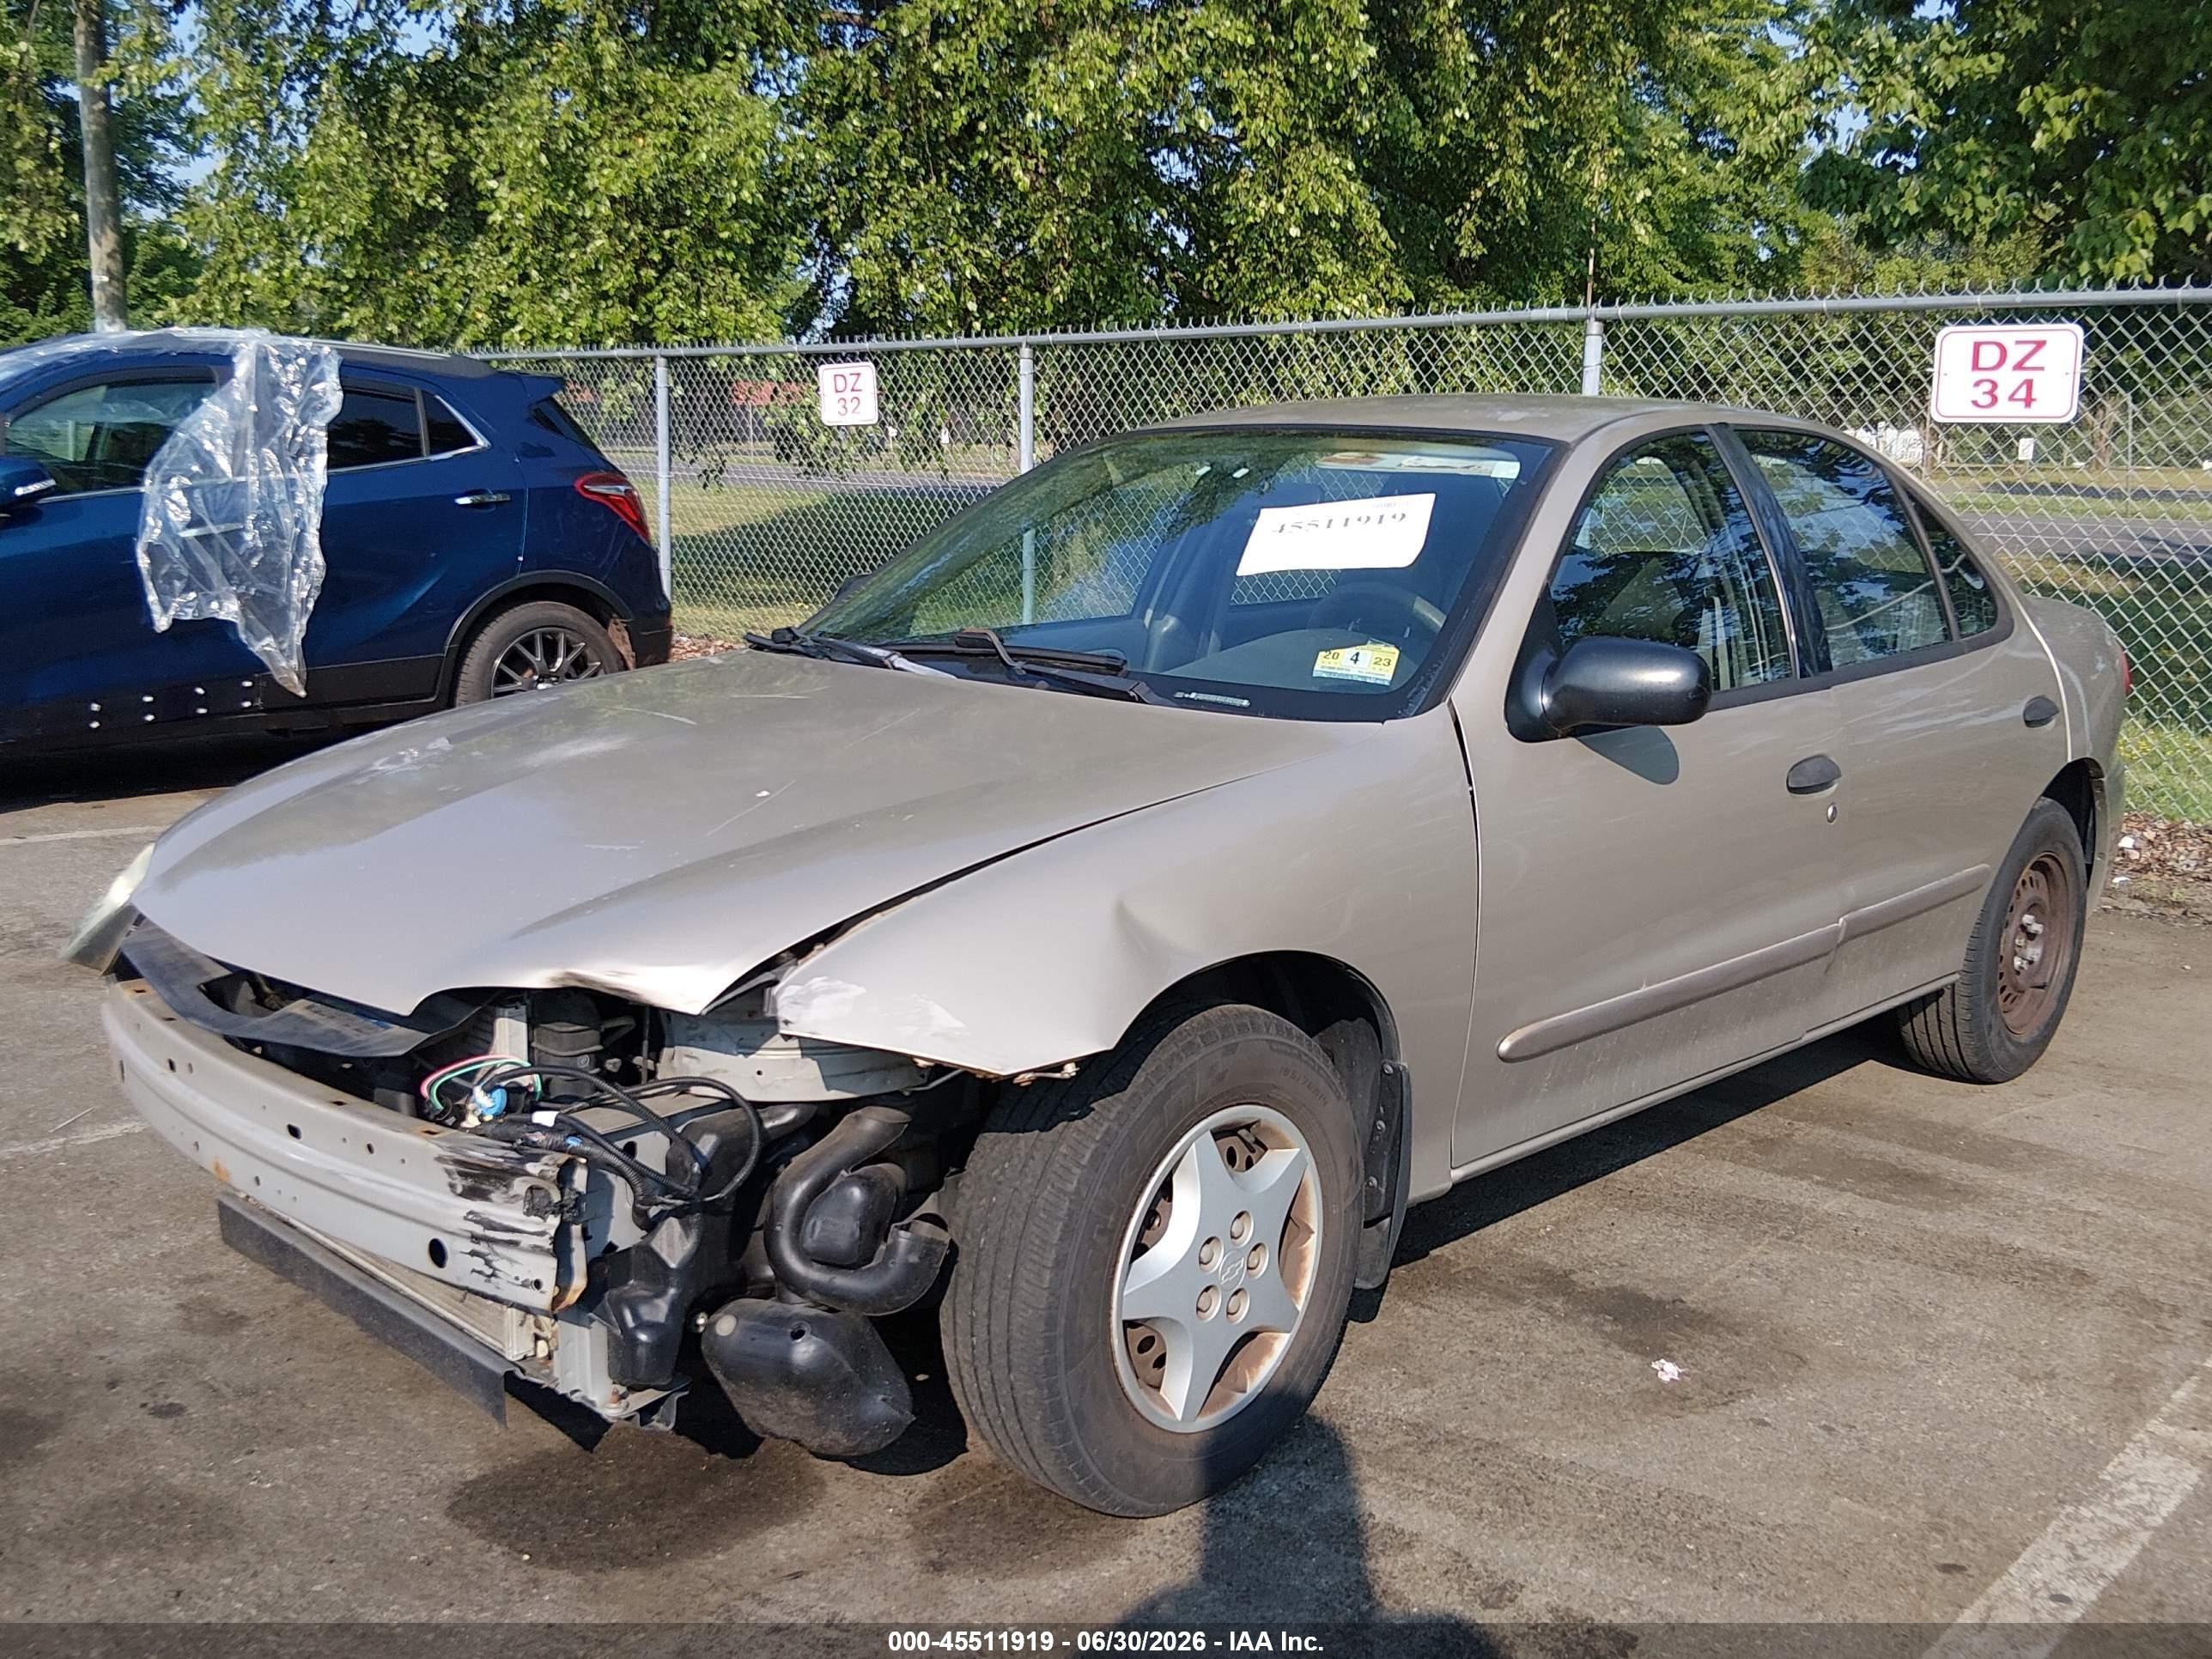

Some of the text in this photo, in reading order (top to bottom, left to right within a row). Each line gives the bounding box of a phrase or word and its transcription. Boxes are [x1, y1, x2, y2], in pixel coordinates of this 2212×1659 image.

[1971, 339, 2048, 372] DZ
[833, 373, 863, 393] DZ
[1971, 378, 2037, 409] 34
[837, 397, 861, 416] 32
[1272, 513, 1407, 534] 45511919
[1323, 650, 1391, 667] 20 4 23
